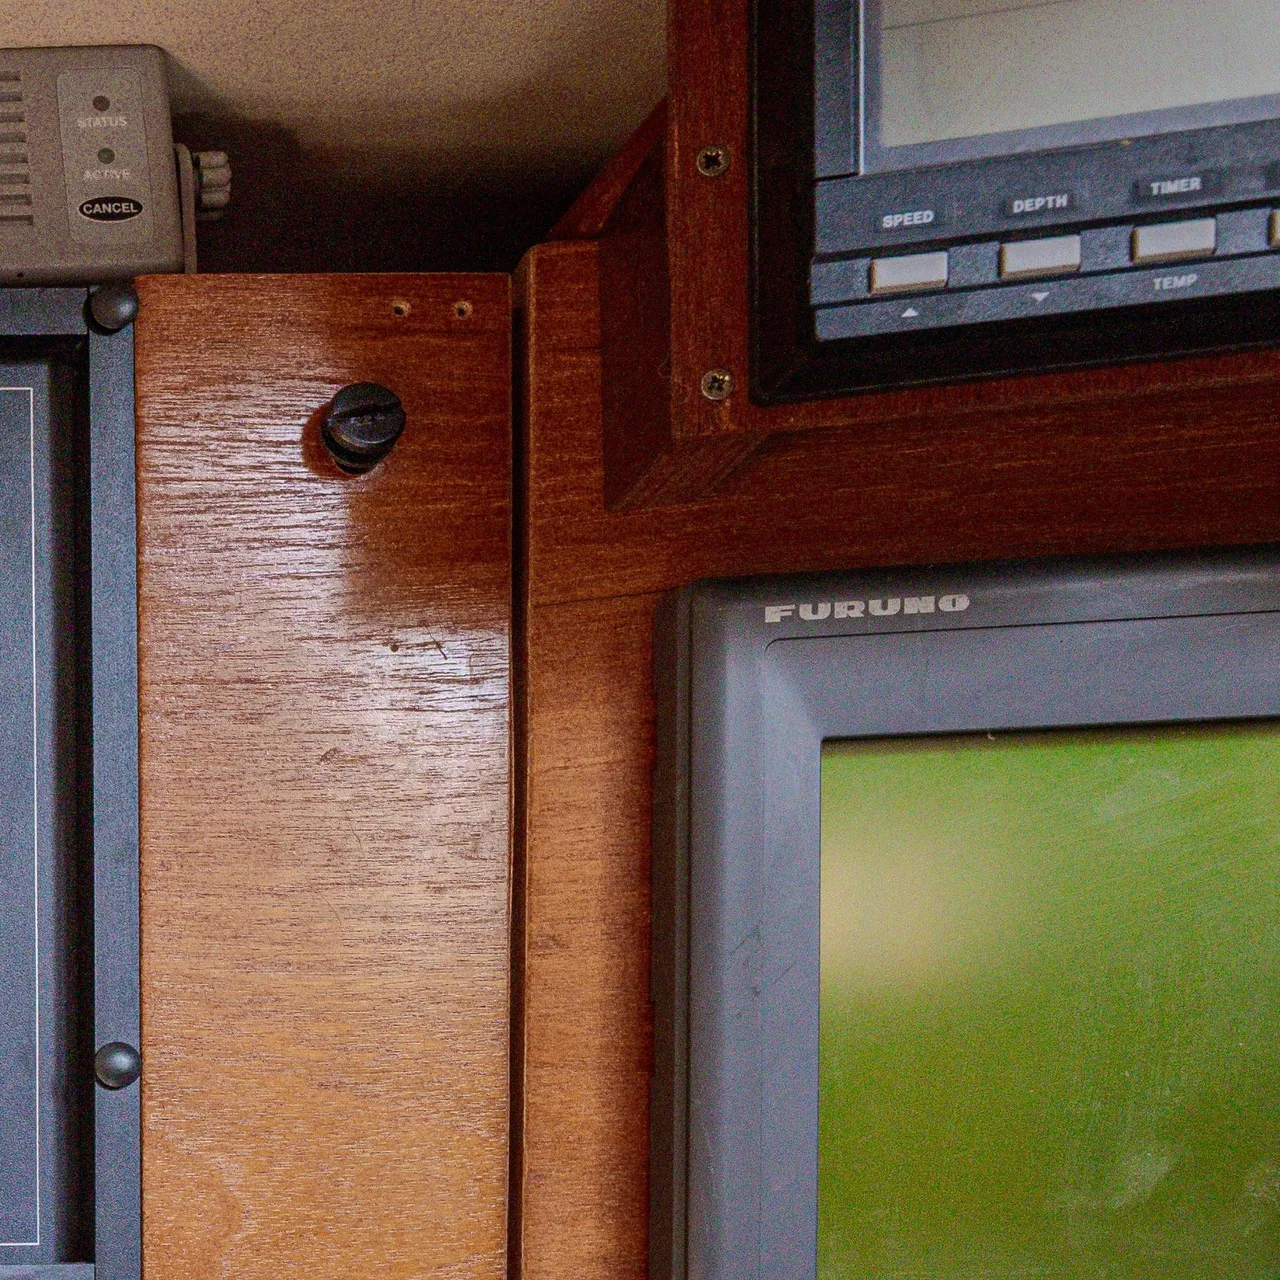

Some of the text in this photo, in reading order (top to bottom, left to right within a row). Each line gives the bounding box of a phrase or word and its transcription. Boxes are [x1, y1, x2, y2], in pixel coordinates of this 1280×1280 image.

[77, 116, 127, 128] STATUS
[82, 169, 131, 181] ACTIVE
[1151, 177, 1201, 195] TIMER
[82, 201, 138, 215] CANCEL
[1013, 194, 1067, 214] DEPTH
[883, 210, 934, 228] SPEED
[1154, 274, 1198, 290] TEMP
[765, 594, 970, 623] FURUNO
